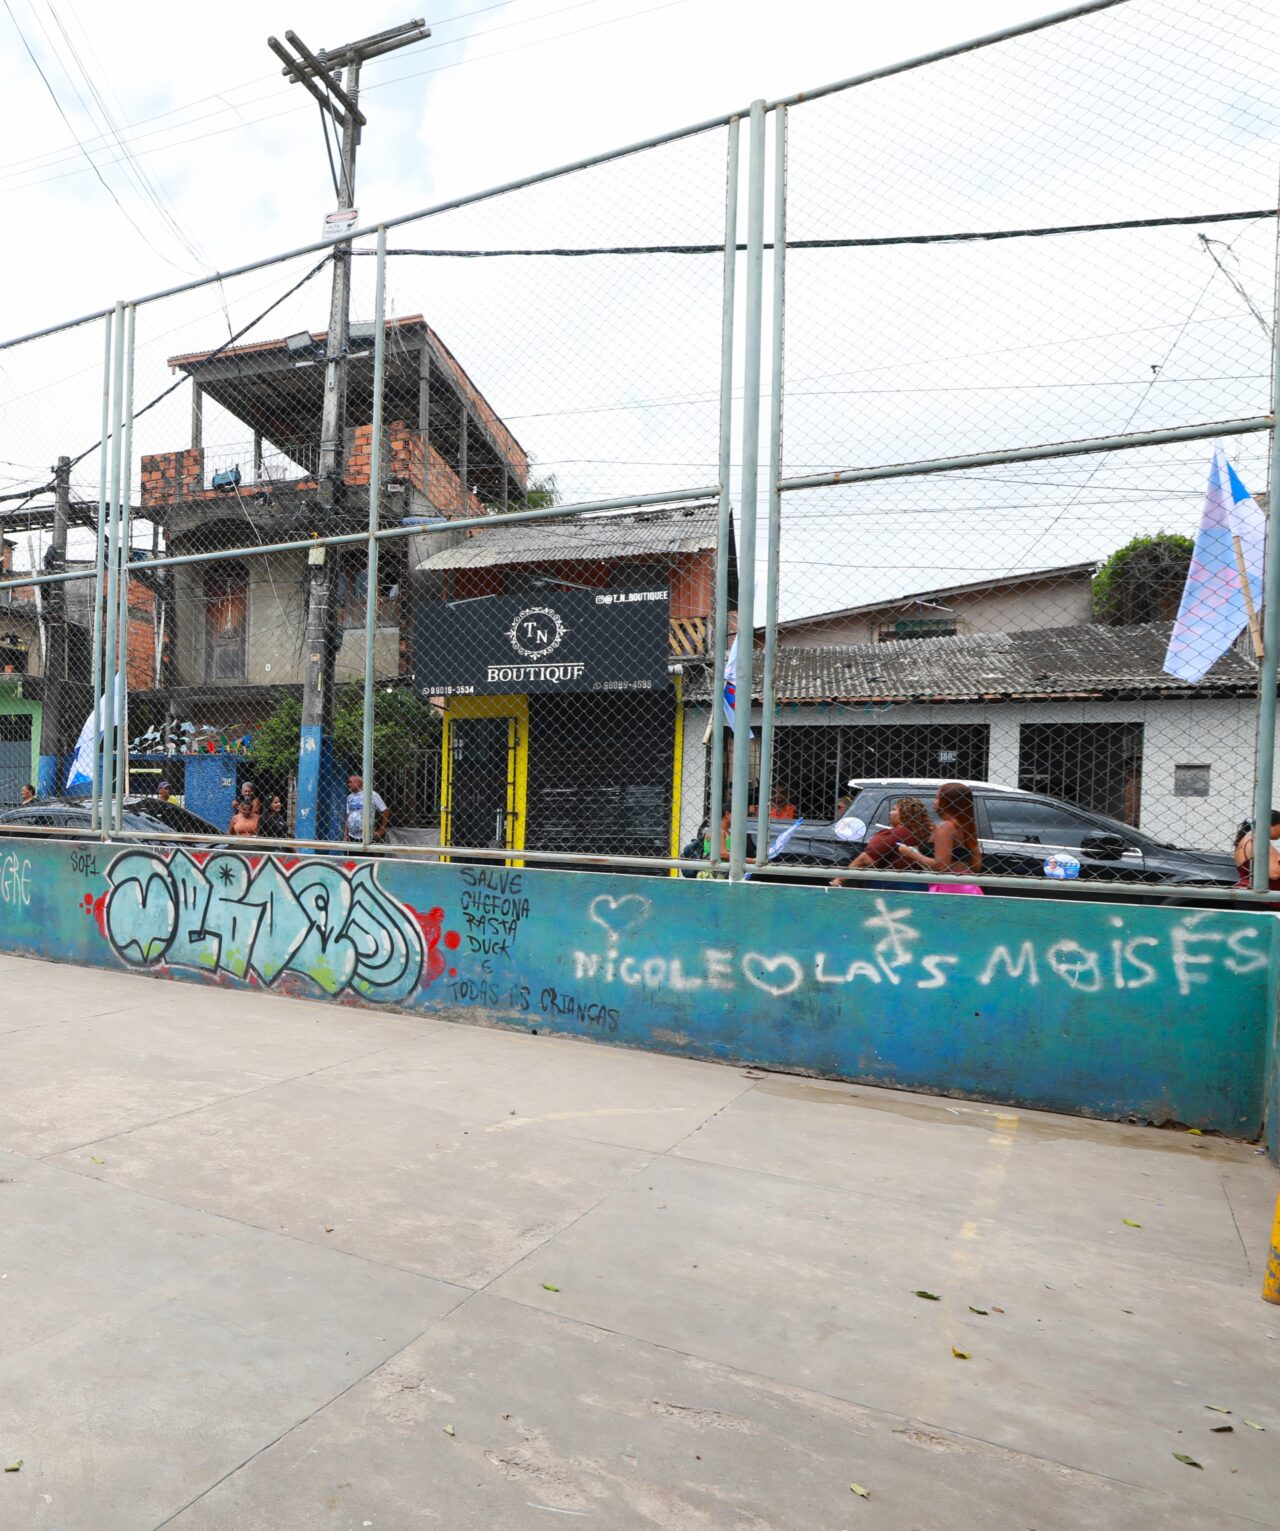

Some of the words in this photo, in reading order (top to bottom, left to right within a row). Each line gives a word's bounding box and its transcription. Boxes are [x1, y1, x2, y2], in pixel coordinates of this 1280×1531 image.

[460, 867, 523, 894] SALVE
[460, 891, 530, 921] CHEFONA
[463, 912, 518, 942] RASTA
[448, 980, 500, 1005] TODAS
[509, 986, 531, 1011] AS
